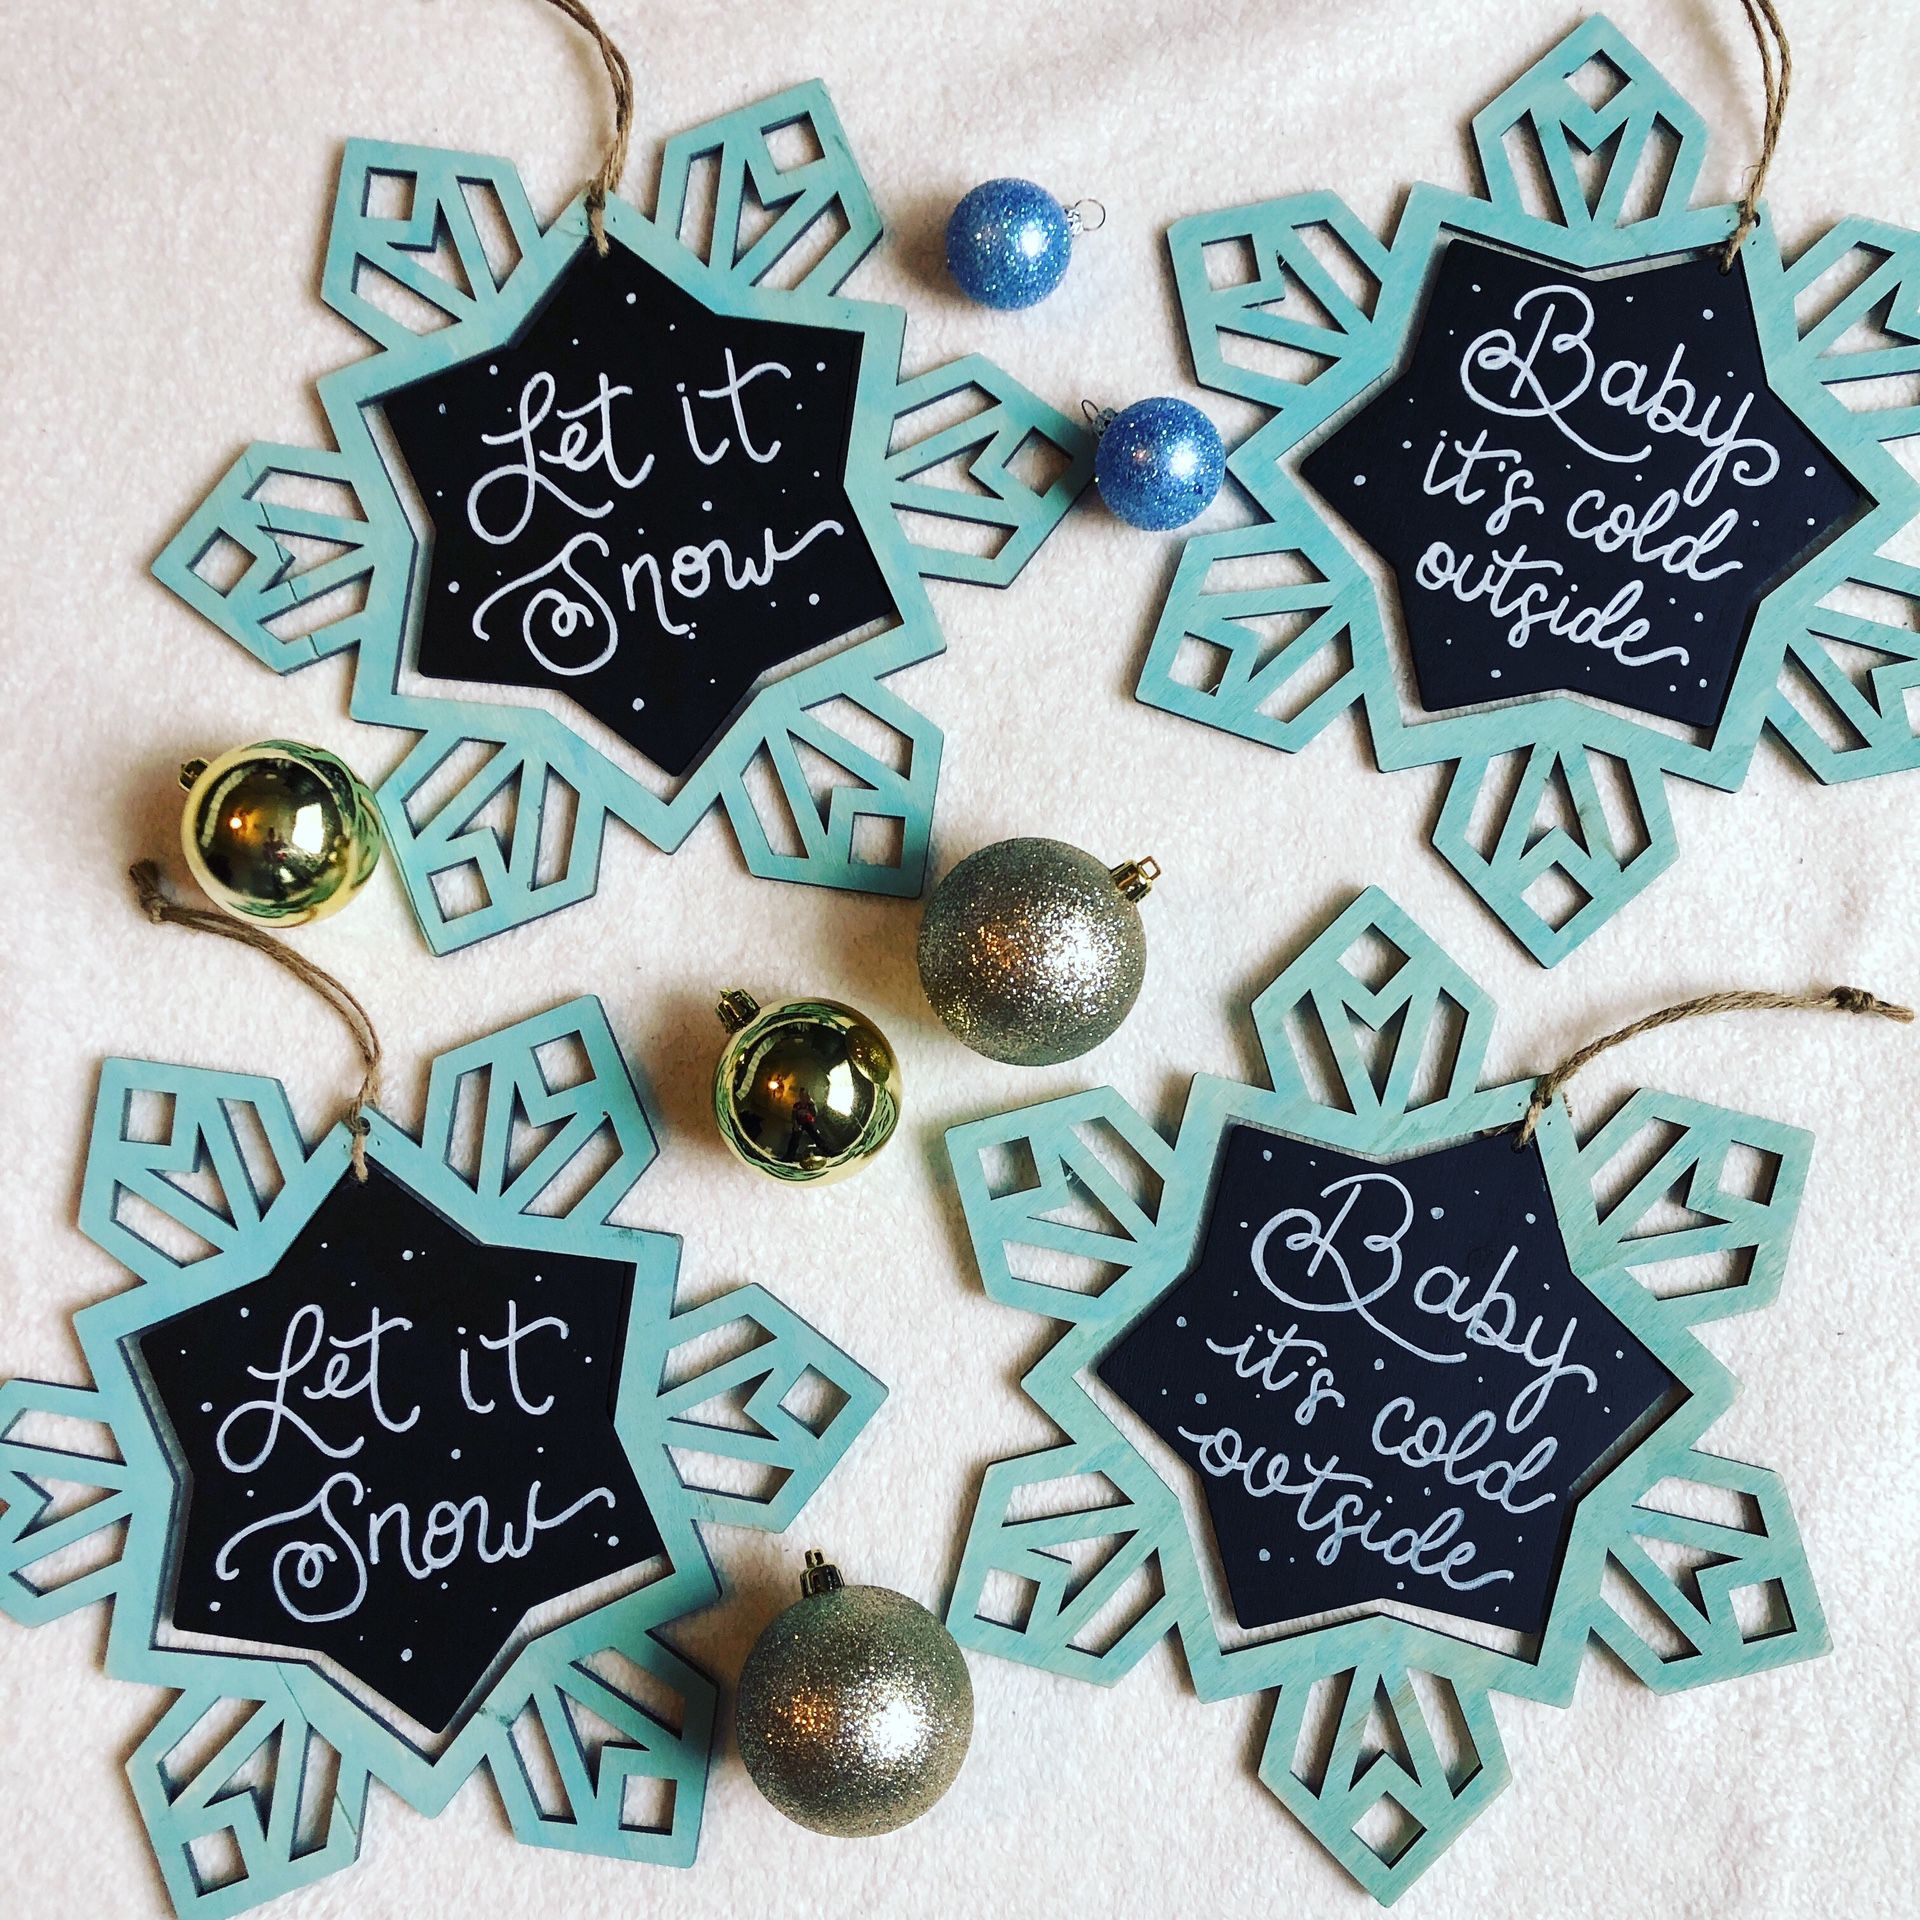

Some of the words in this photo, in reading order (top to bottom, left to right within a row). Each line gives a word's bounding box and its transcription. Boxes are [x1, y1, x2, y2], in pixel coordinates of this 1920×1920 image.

[467, 371, 654, 544] Let
[676, 348, 792, 464] it
[1460, 284, 1780, 507] Baby
[1423, 430, 1544, 535] it's
[1566, 489, 1743, 581] cold
[472, 520, 844, 675] Snow
[1416, 541, 1689, 666] outside
[216, 1304, 420, 1473] Let
[458, 1300, 569, 1415] it
[1251, 1172, 1598, 1433] Baby
[1206, 1324, 1345, 1425] it's
[1372, 1396, 1557, 1513] cold
[215, 1471, 615, 1623] Snow
[1178, 1425, 1514, 1591] outside
